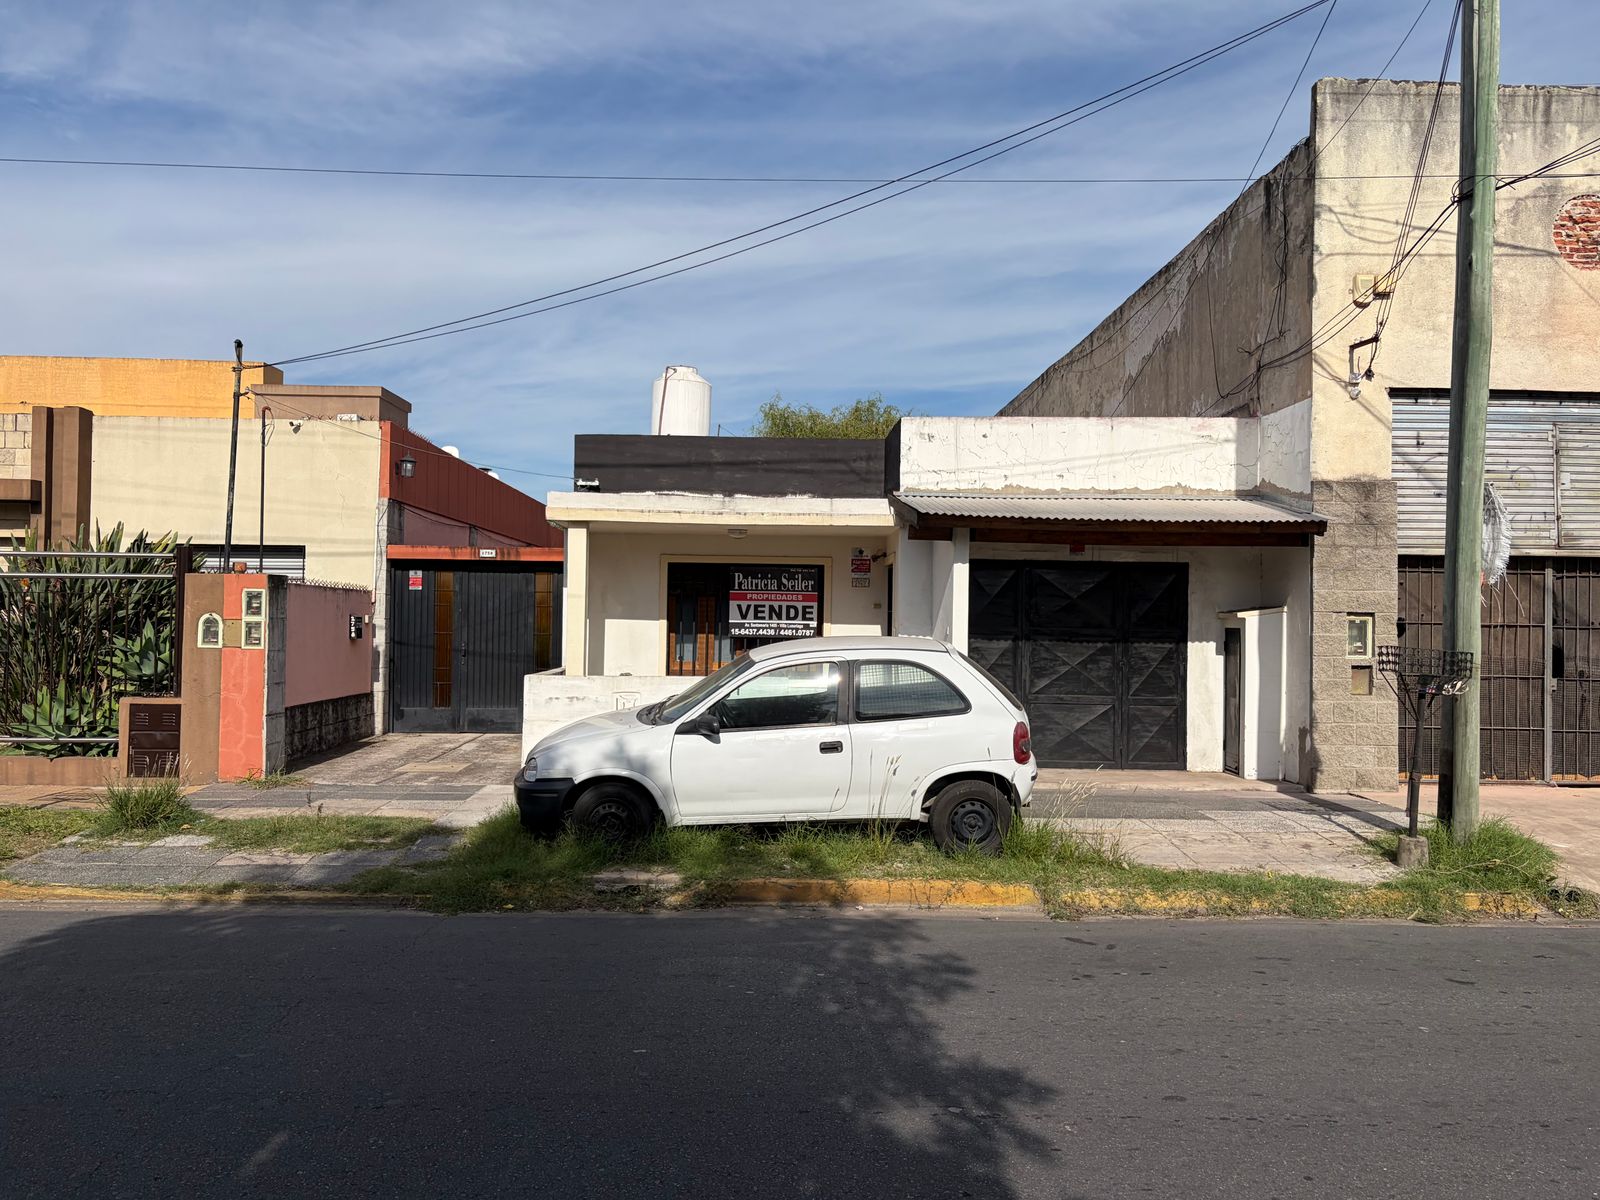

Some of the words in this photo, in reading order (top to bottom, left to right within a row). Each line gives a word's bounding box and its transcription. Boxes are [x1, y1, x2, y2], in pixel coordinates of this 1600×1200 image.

[734, 572, 778, 590] Patricia
[781, 573, 814, 591] Seiler
[746, 593, 803, 601] PROPIEDADES
[736, 604, 814, 621] VENDE
